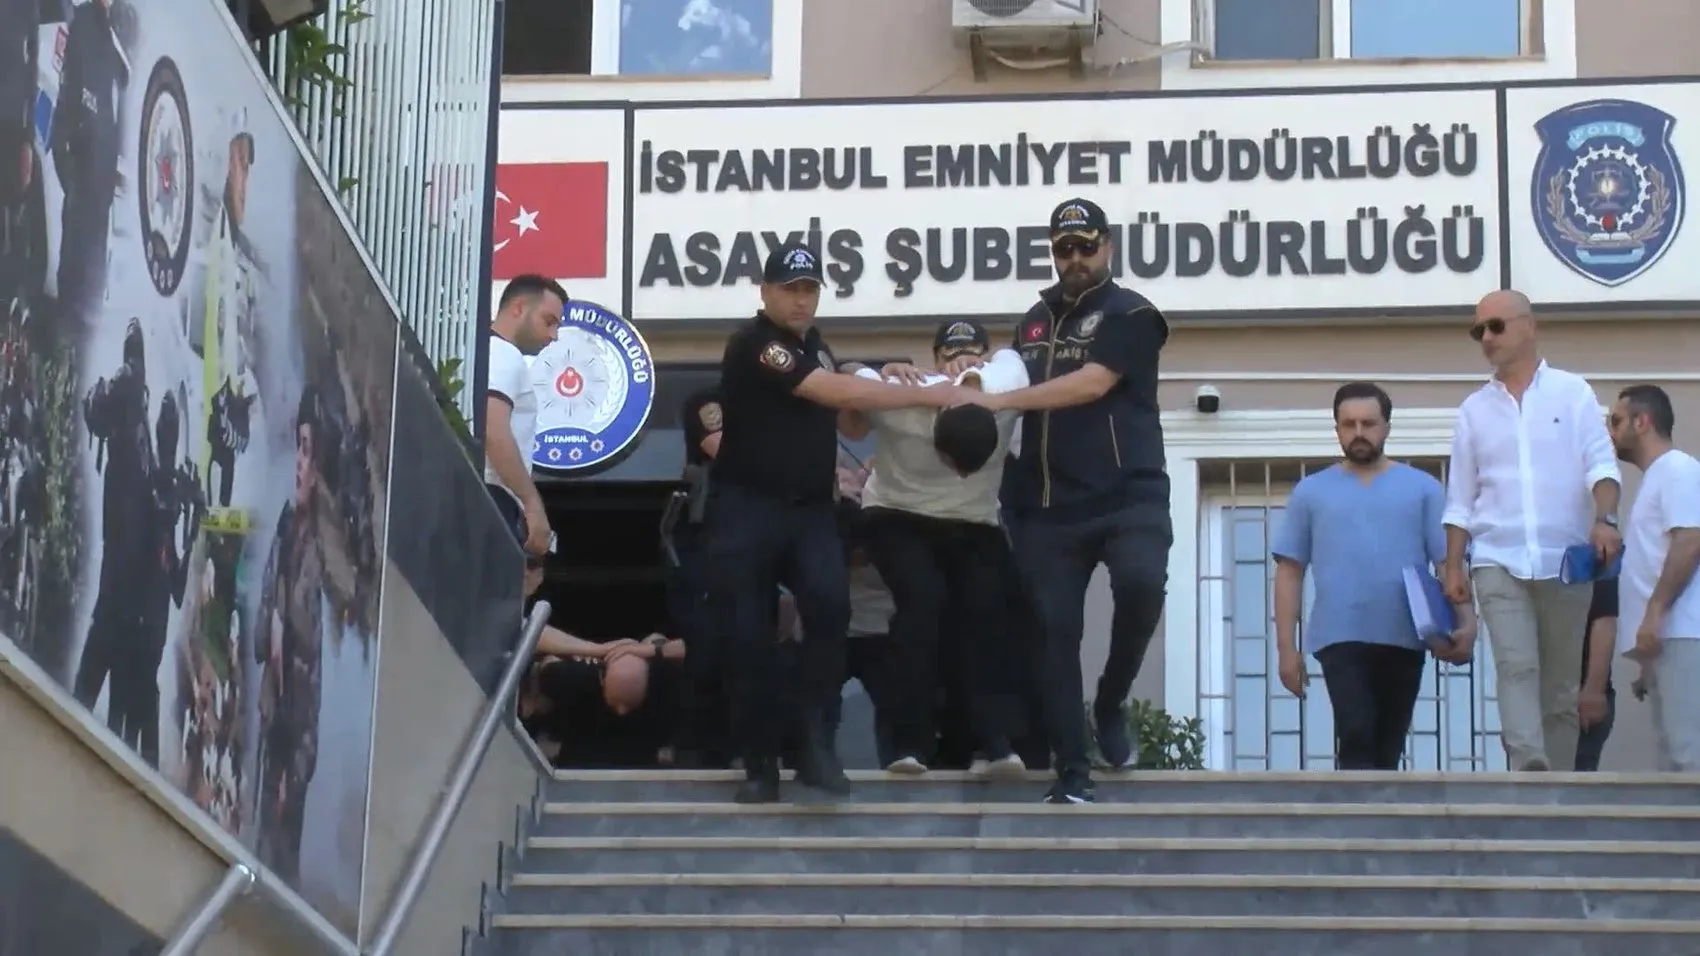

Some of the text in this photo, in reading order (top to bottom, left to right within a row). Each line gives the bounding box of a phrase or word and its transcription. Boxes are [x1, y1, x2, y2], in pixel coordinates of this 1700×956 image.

[639, 123, 1478, 195] İSTANBUL EMNİYET MÜDÜRLÜĞÜ
[884, 226, 1053, 299] ŞUBE
[1109, 204, 1486, 280] ÜDÜRLÜĞÜ
[569, 307, 650, 384] MÜDÜRLÜĞÜ
[543, 434, 589, 444] İSTANBUL
